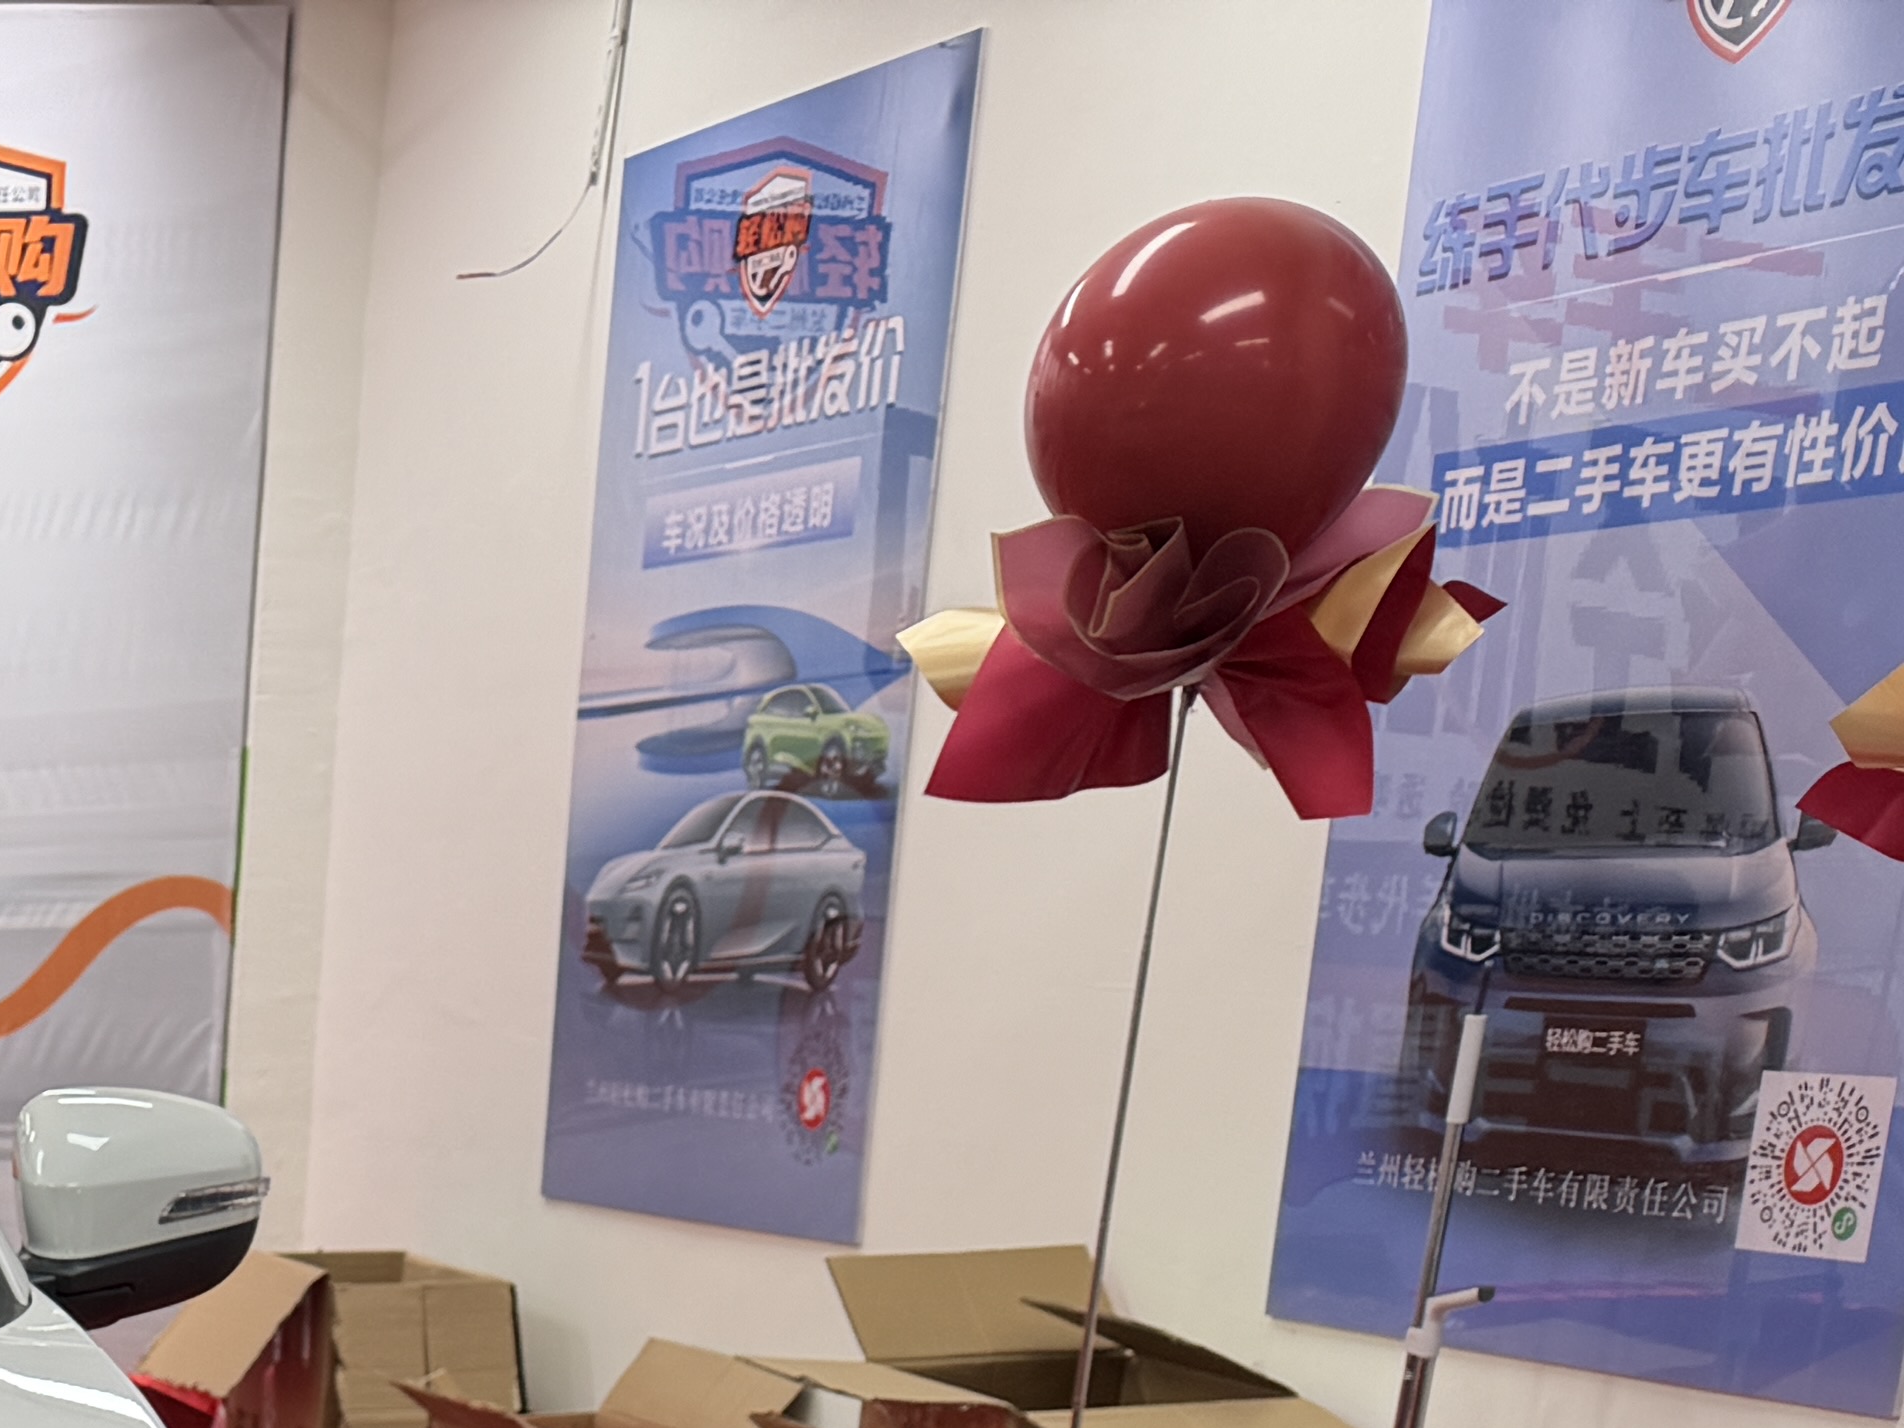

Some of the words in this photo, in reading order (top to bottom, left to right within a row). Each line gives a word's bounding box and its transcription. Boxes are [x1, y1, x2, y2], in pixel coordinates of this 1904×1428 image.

[1504, 293, 1889, 425] 不是新车买不起
[1438, 401, 1904, 535] 而是二手车更有性价
[659, 481, 834, 556] 车况及价格透明
[1530, 908, 1692, 927] DISCOVERY
[1544, 1027, 1643, 1057] 轻松购二手车
